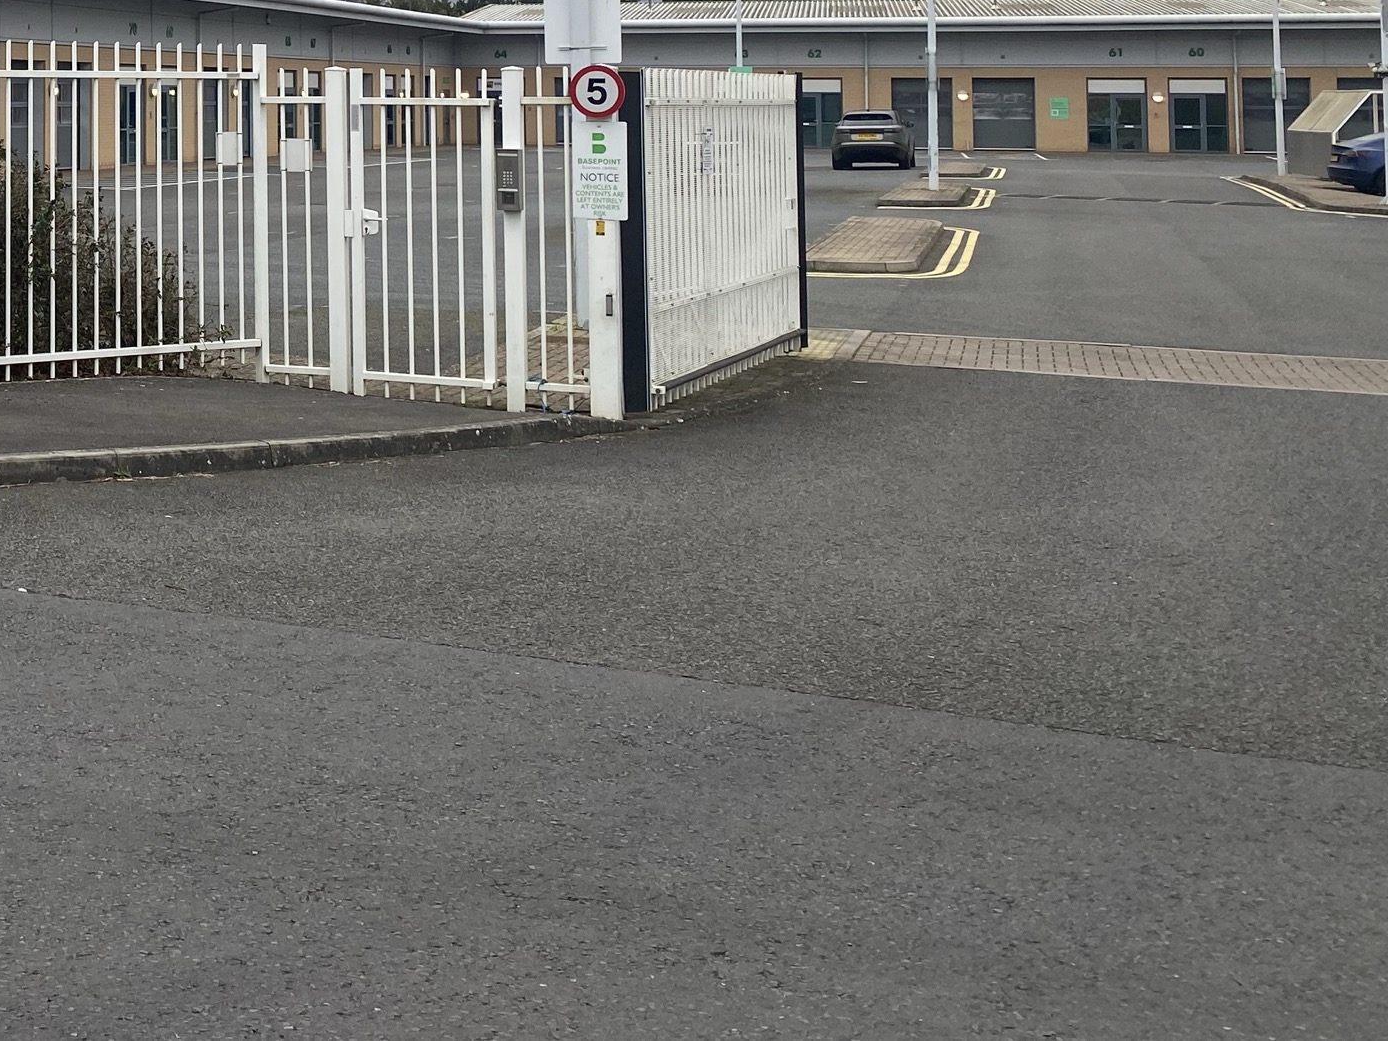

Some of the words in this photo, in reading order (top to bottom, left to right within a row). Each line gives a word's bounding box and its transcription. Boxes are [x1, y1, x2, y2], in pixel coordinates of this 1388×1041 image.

[128, 22, 138, 36] 70
[494, 49, 508, 59] 64
[807, 49, 822, 58] 62
[1108, 47, 1123, 57] 61
[1188, 47, 1205, 57] 60
[587, 78, 607, 105] 5
[580, 172, 620, 182] NOTICE
